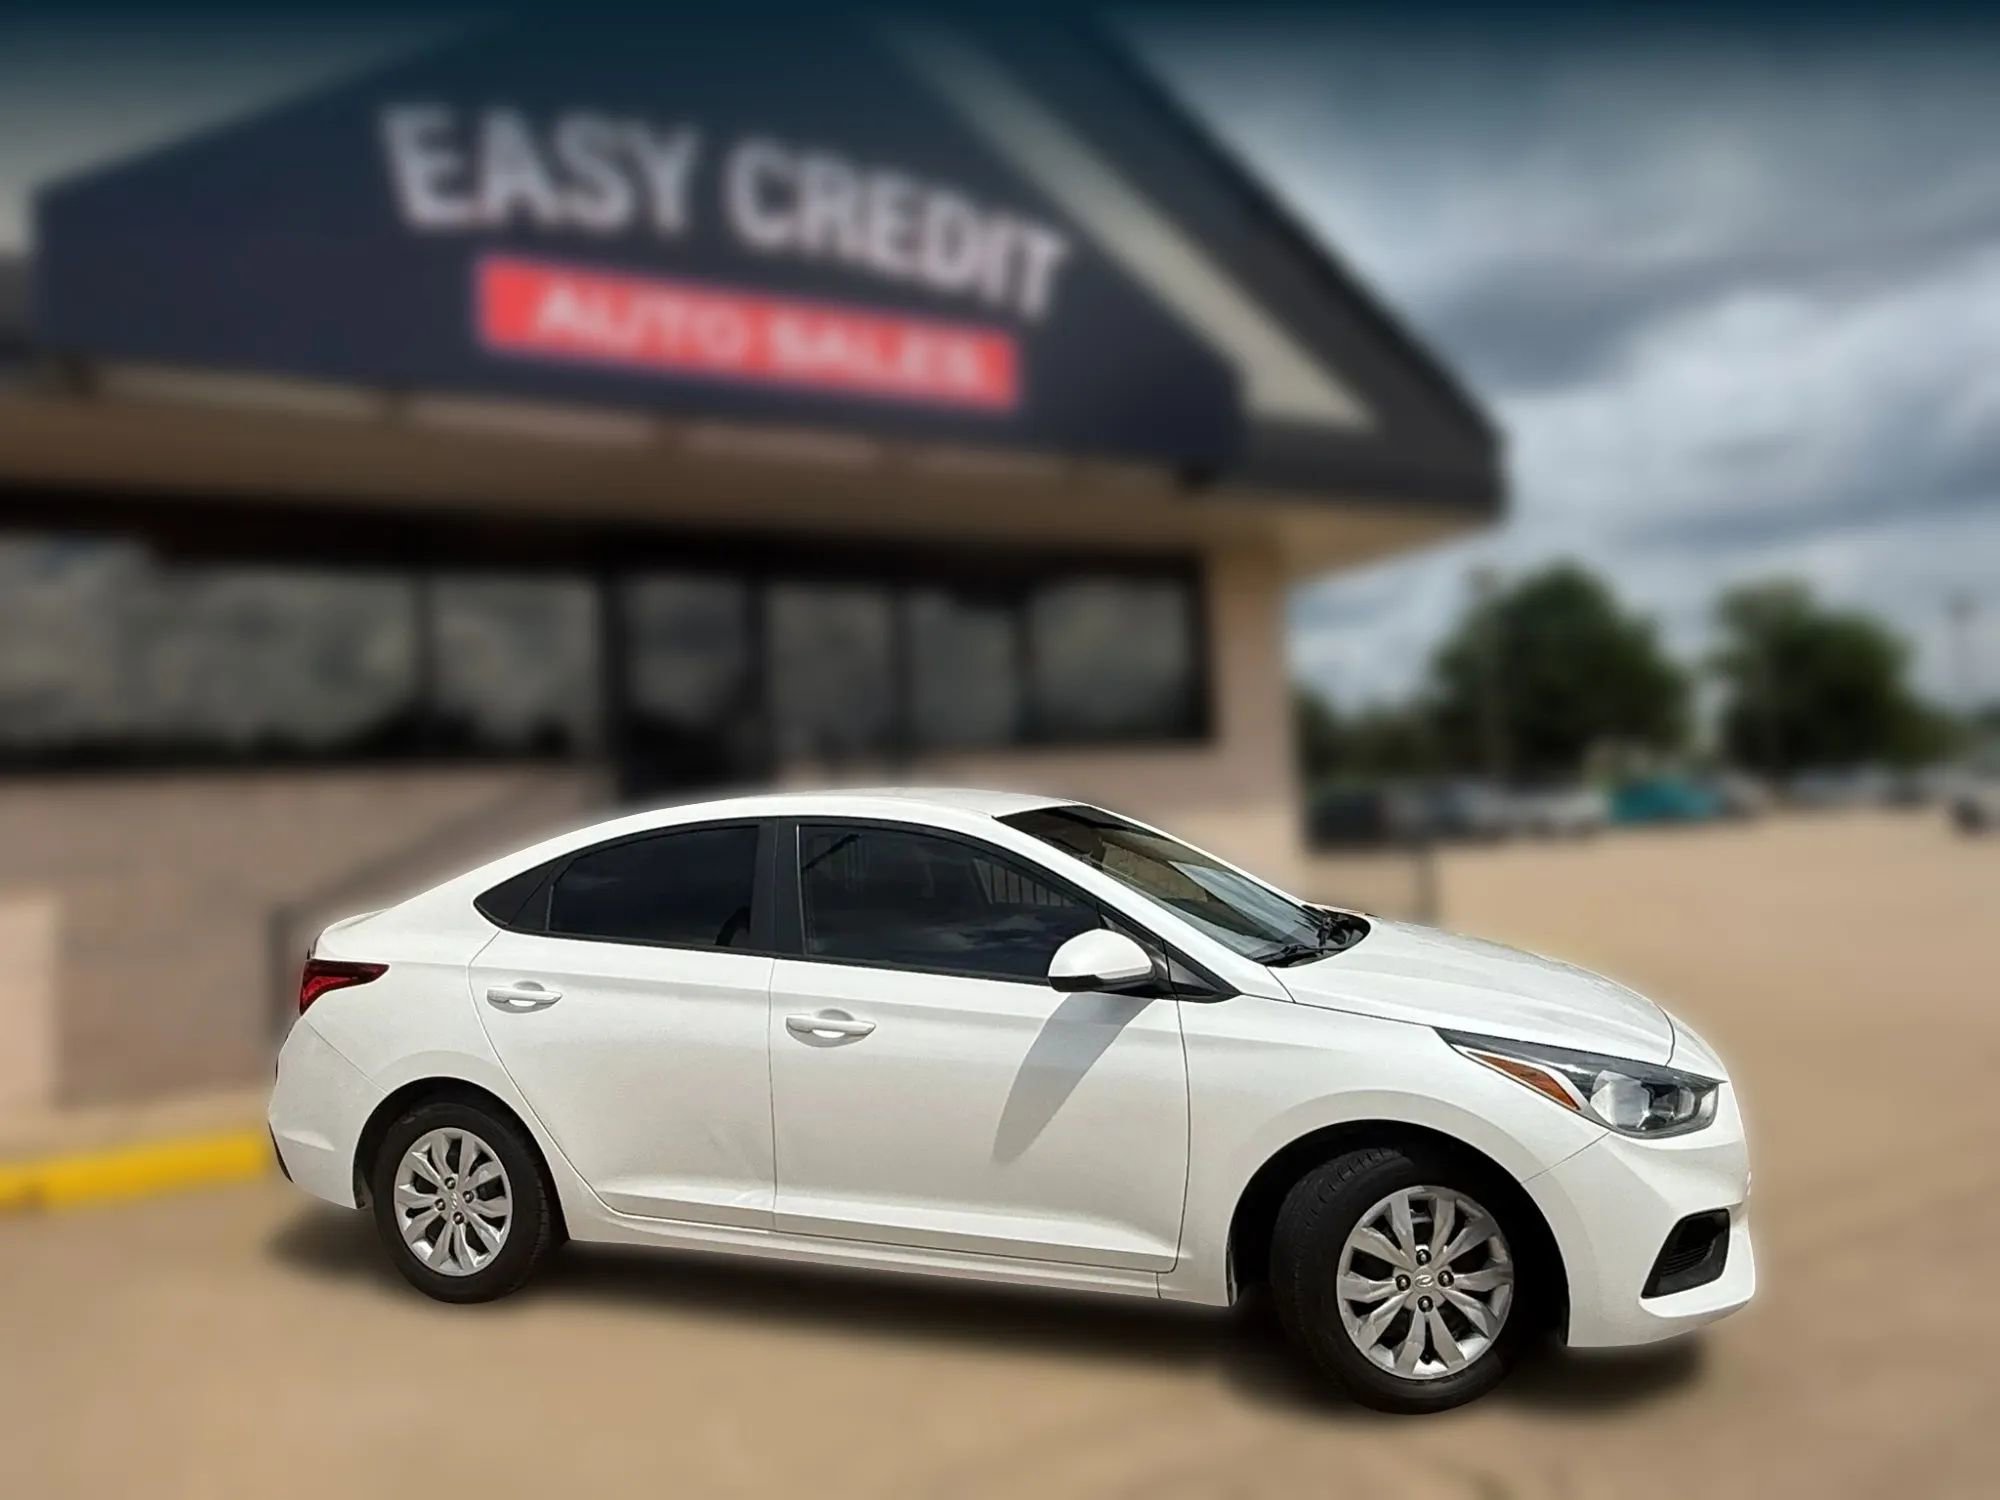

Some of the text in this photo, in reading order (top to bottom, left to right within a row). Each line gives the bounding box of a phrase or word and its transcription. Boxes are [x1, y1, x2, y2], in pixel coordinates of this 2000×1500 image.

[384, 106, 1064, 316] EASY CREDIT
[534, 281, 984, 391] AUTO SALES
